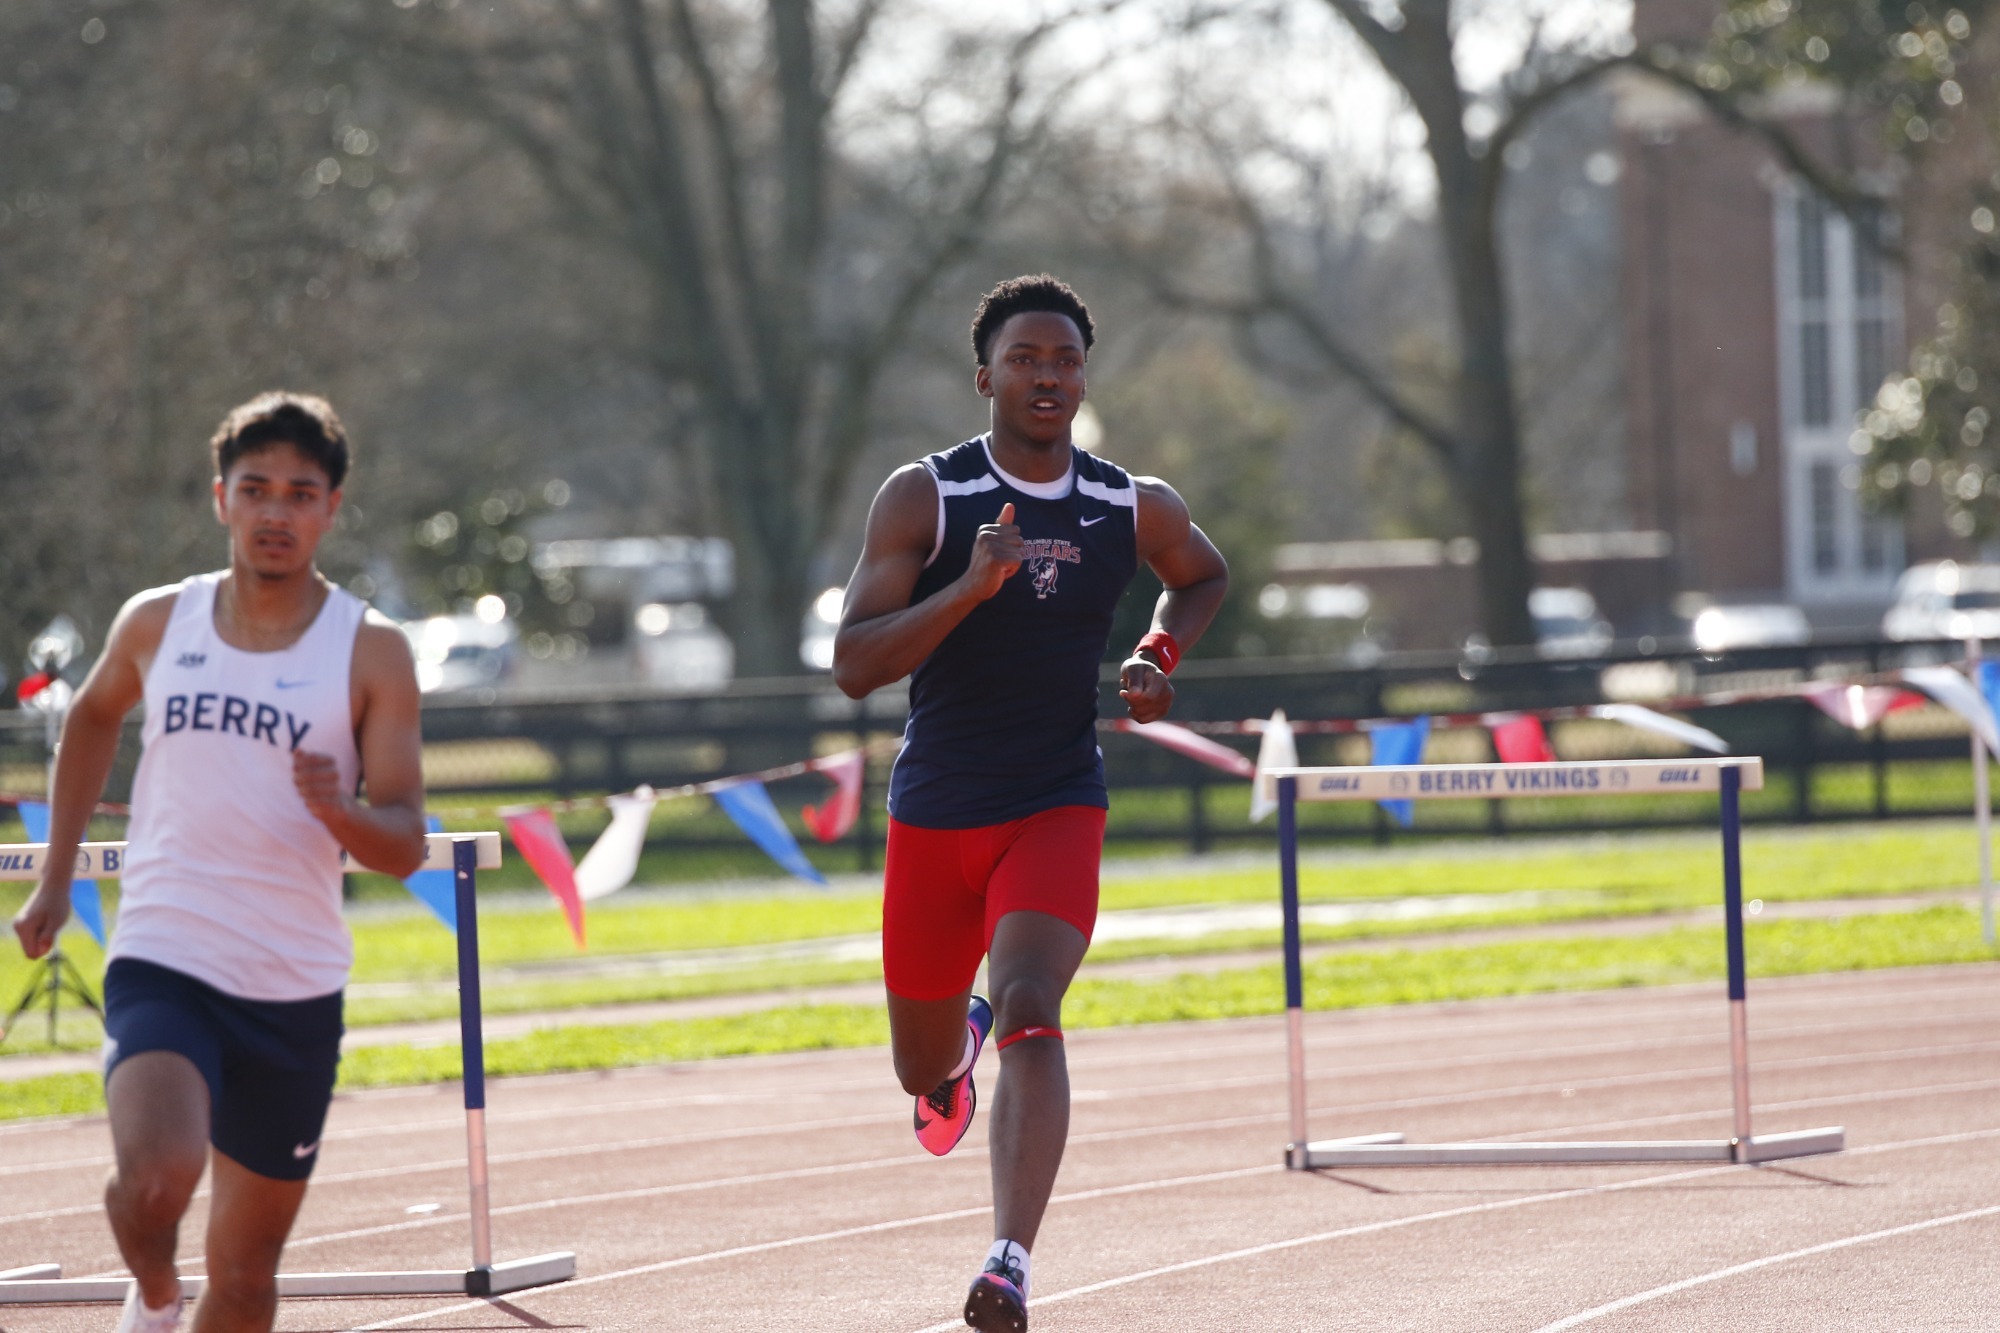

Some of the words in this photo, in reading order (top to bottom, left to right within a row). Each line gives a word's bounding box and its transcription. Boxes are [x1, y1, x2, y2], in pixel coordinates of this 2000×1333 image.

[1023, 545, 1081, 563] OUGARS
[165, 693, 312, 754] BERRY
[1419, 769, 1495, 792] BERRY
[1504, 767, 1600, 790] VIKINGS
[1659, 768, 1701, 783] GILL
[0, 855, 33, 870] ILL
